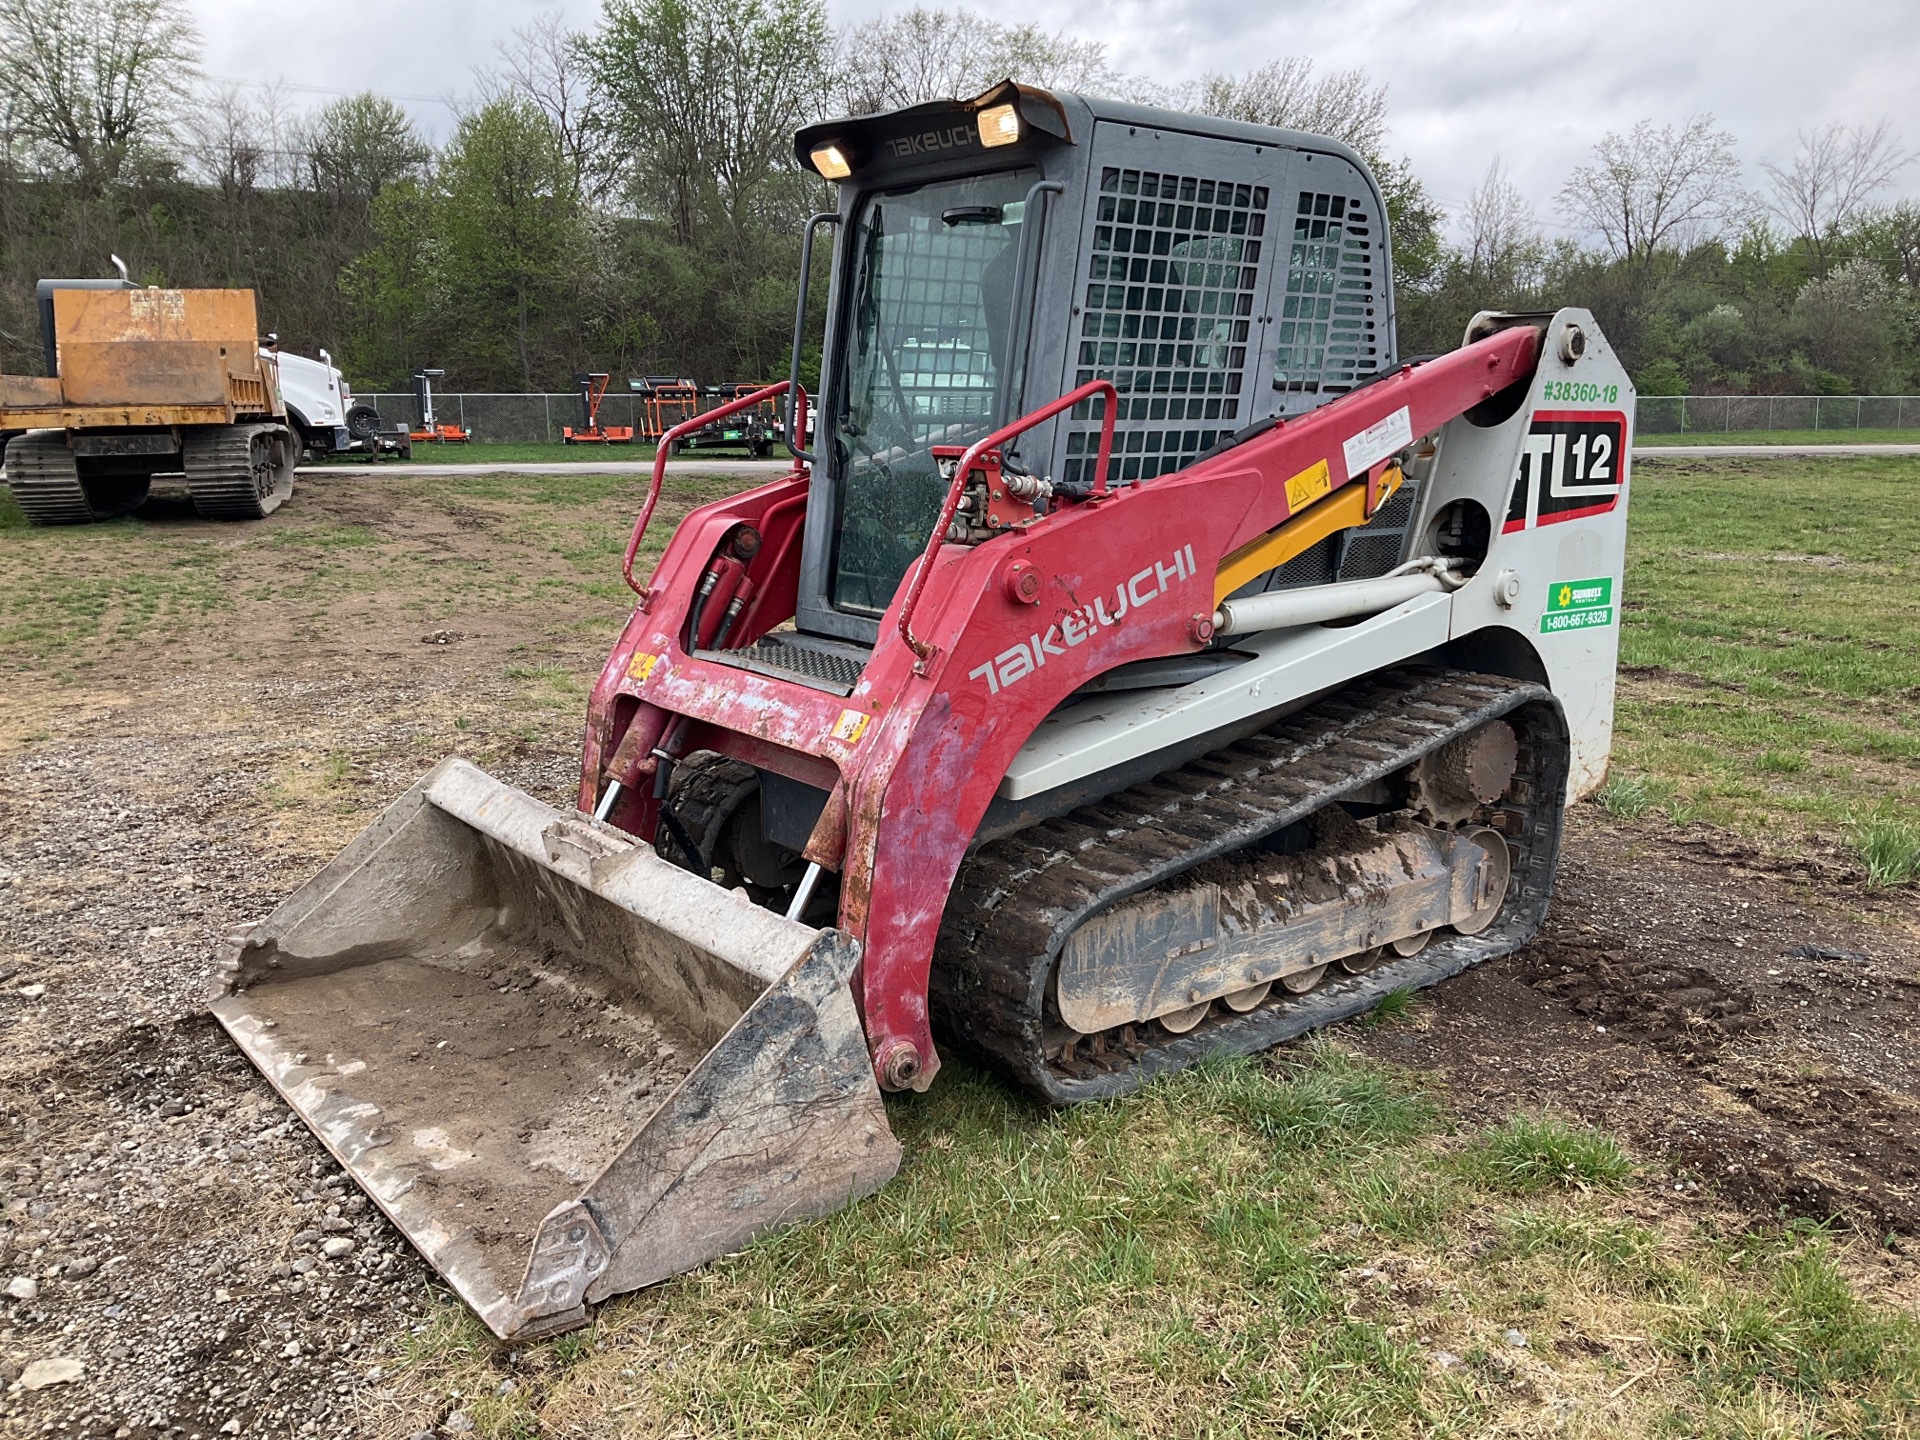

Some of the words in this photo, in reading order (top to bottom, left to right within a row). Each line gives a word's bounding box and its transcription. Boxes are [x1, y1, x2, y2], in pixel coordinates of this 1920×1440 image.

[887, 123, 978, 157] TAKEUCH
[1544, 381, 1618, 403] #38360-18
[969, 543, 1196, 695] TAKEUCHI
[1546, 610, 1608, 630] 1-800-667-9328
